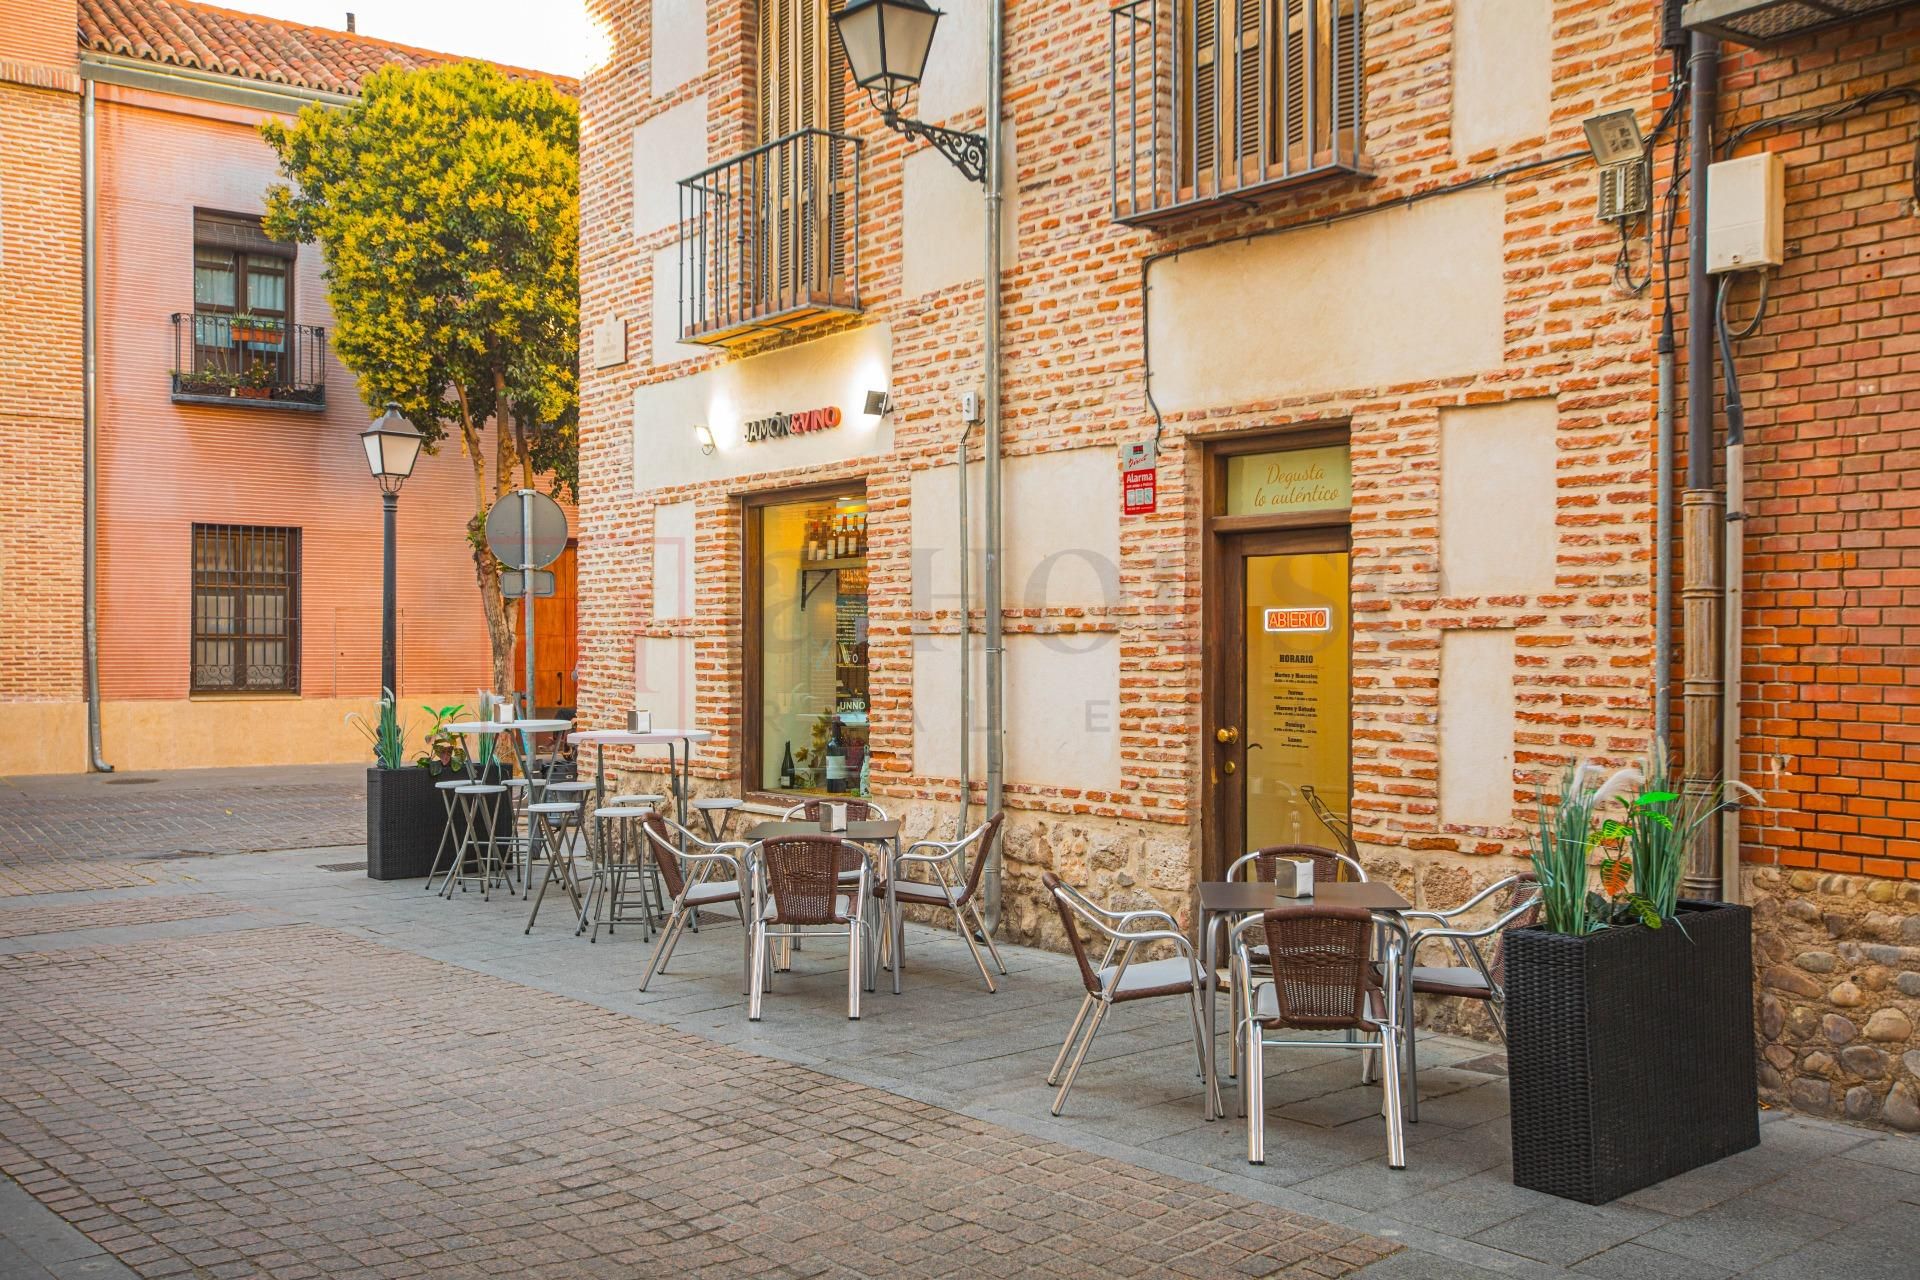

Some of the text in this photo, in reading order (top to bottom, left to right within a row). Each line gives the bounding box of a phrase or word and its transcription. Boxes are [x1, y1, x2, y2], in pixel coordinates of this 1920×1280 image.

[1126, 473, 1153, 484] Alarma
[1267, 463, 1325, 488] Degusta
[1254, 484, 1339, 507] lo auténtico
[1269, 611, 1325, 628] ABIERTO
[1279, 654, 1314, 664] HORARIO
